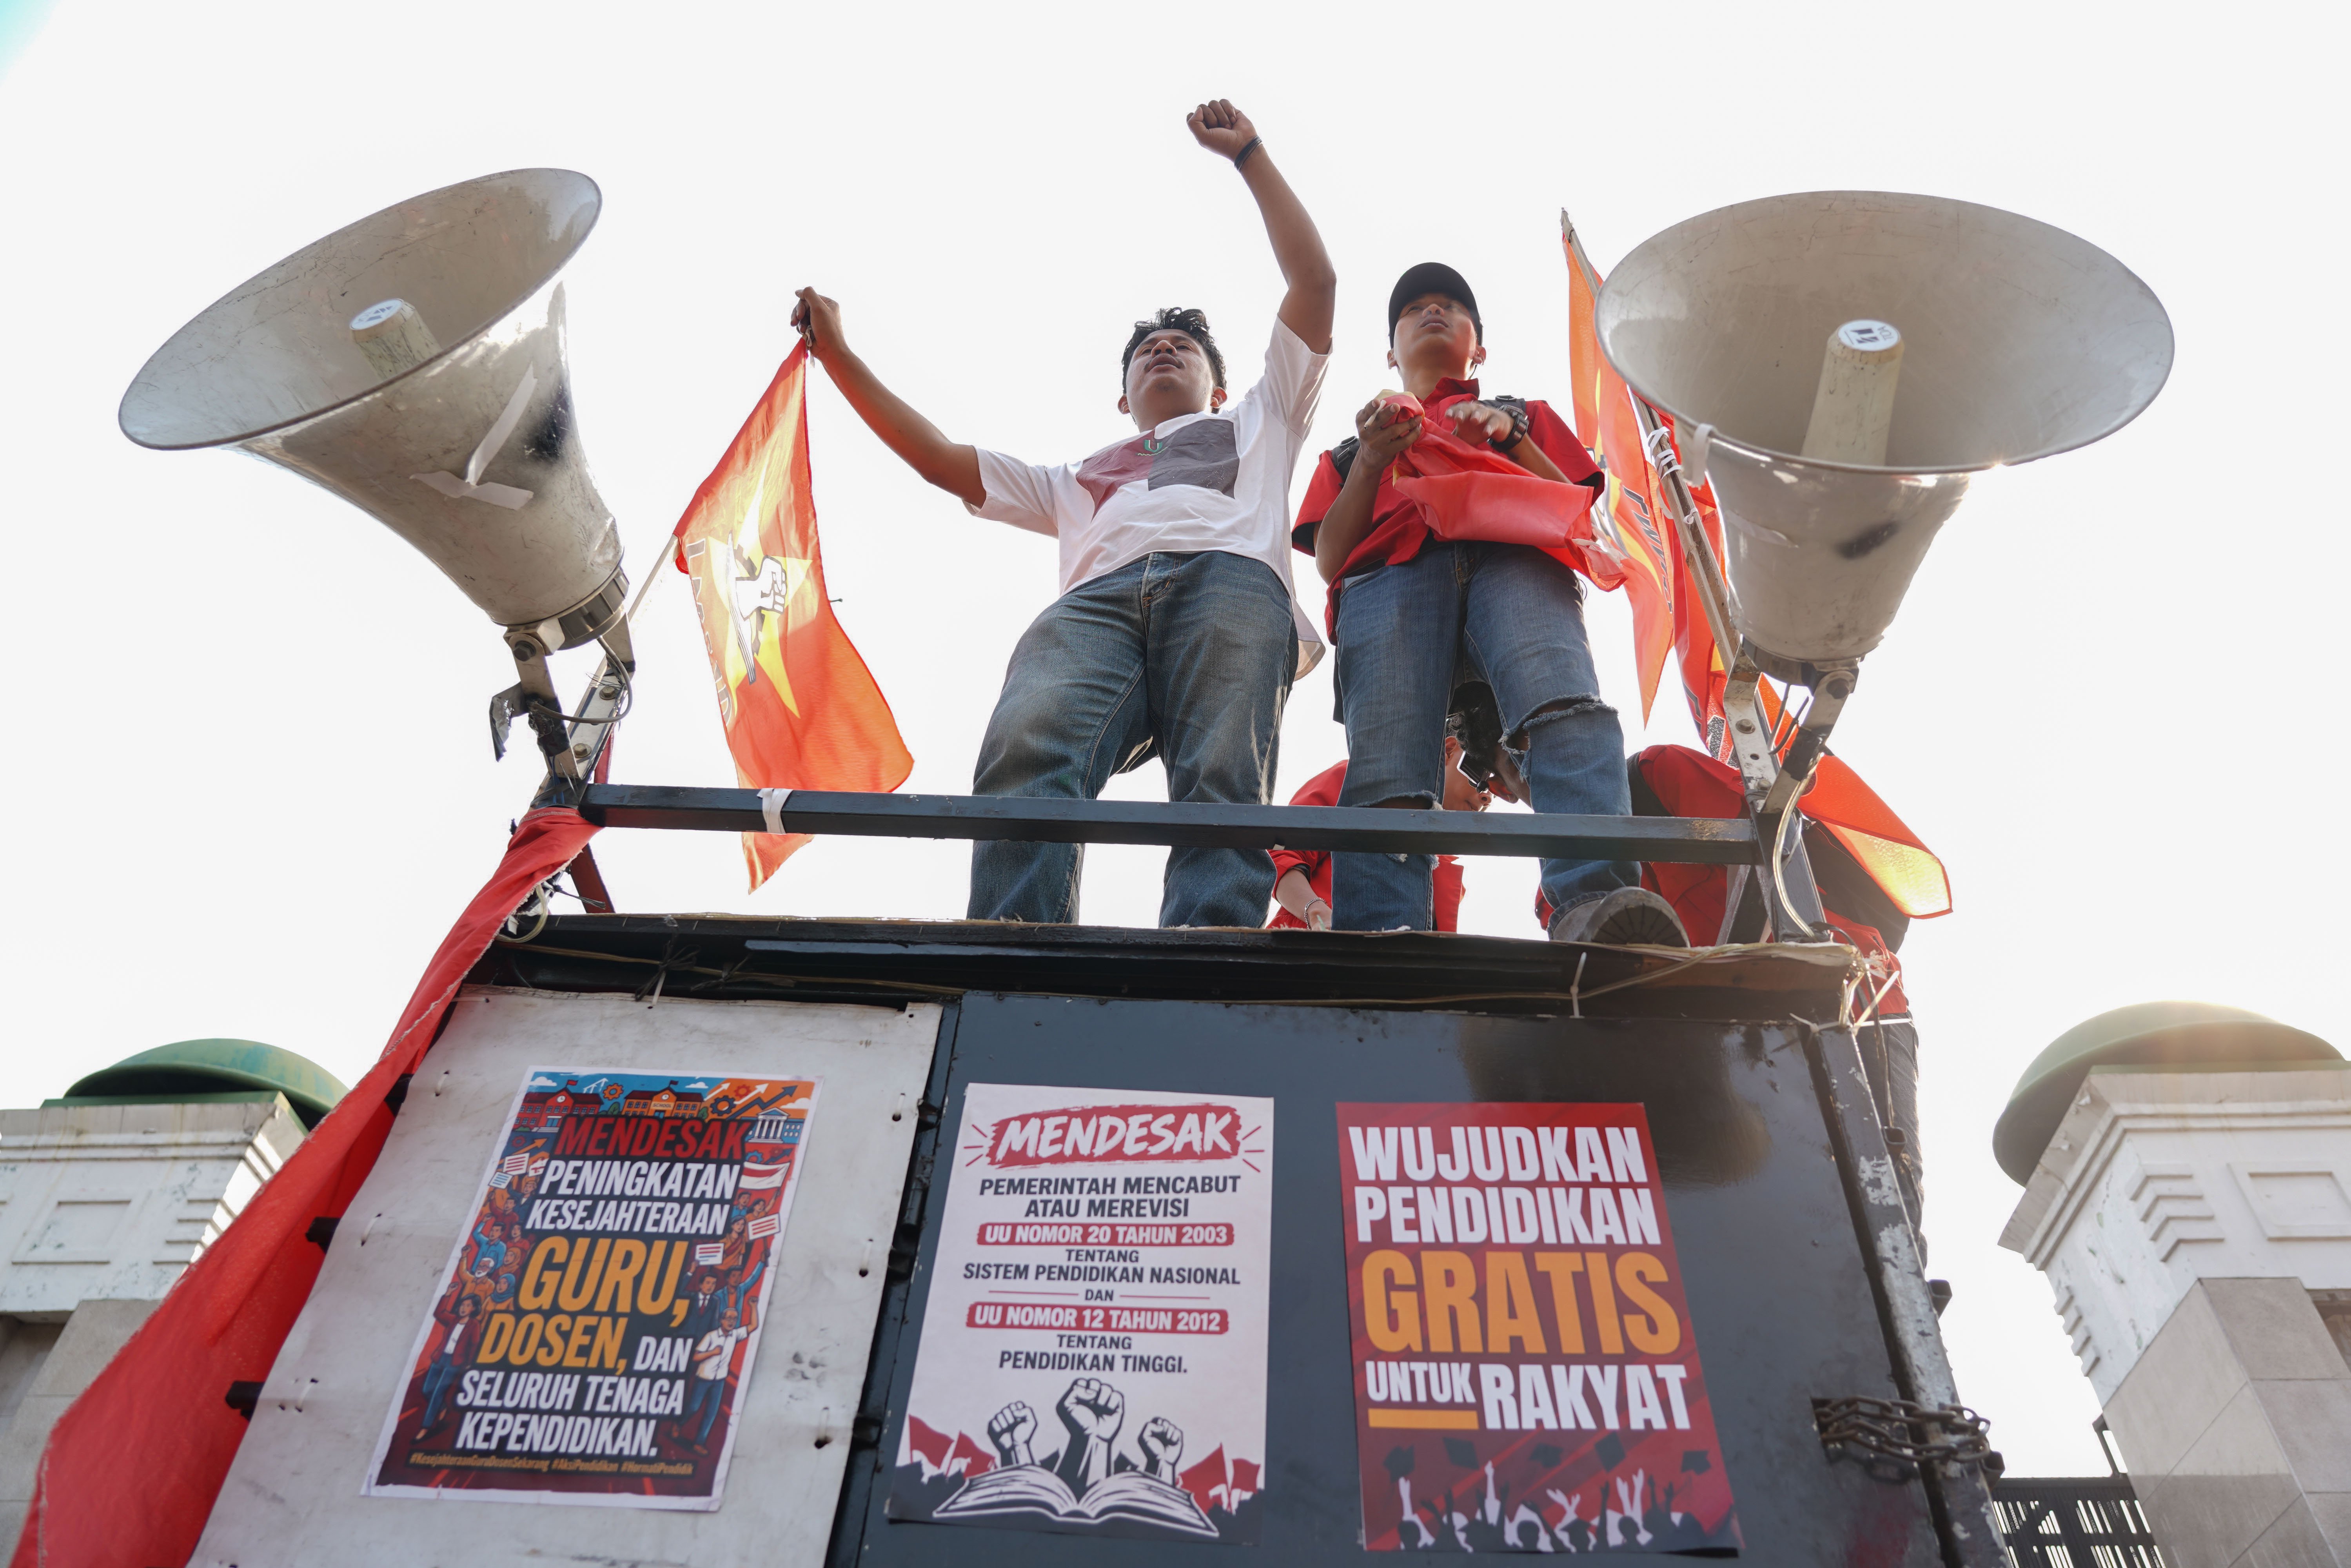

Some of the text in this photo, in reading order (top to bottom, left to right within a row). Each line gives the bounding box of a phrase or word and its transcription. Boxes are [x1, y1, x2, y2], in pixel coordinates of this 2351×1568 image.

[555, 1118, 752, 1159] MENDESAK
[995, 1112, 1233, 1161] MENDESAK
[1349, 1127, 1647, 1182] WUJUDKAN
[539, 1160, 740, 1199] PENINGKATAN
[980, 1176, 1240, 1195] PEMERINTAH MENCABUT
[526, 1200, 730, 1234] KESEJAHTERAAN
[1025, 1199, 1188, 1217] ATAU MEREVISI
[1354, 1186, 1661, 1244] PENDIDIKAN
[986, 1225, 1227, 1243] UU NOMOR 20 TAHUN 2003
[964, 1263, 1240, 1284] SISTEM PENDIDIKAN NASIONAL
[1066, 1250, 1138, 1262] TENTANG
[517, 1236, 693, 1328] GURU,
[1086, 1290, 1113, 1301] DAN
[975, 1305, 1220, 1331] UU NOMOR 12 TAHUN 2012
[1362, 1249, 1681, 1355] GRATIS
[477, 1314, 693, 1375] DOSEN, DAN
[1000, 1351, 1186, 1372] PENDIDIKAN TINGGI.
[1058, 1335, 1131, 1349] TENTANG
[457, 1370, 684, 1414] SELURUH TENAGA
[1366, 1361, 1690, 1429] UNTUK RAKYAT
[457, 1412, 657, 1456] KEPENDIDIKAN.
